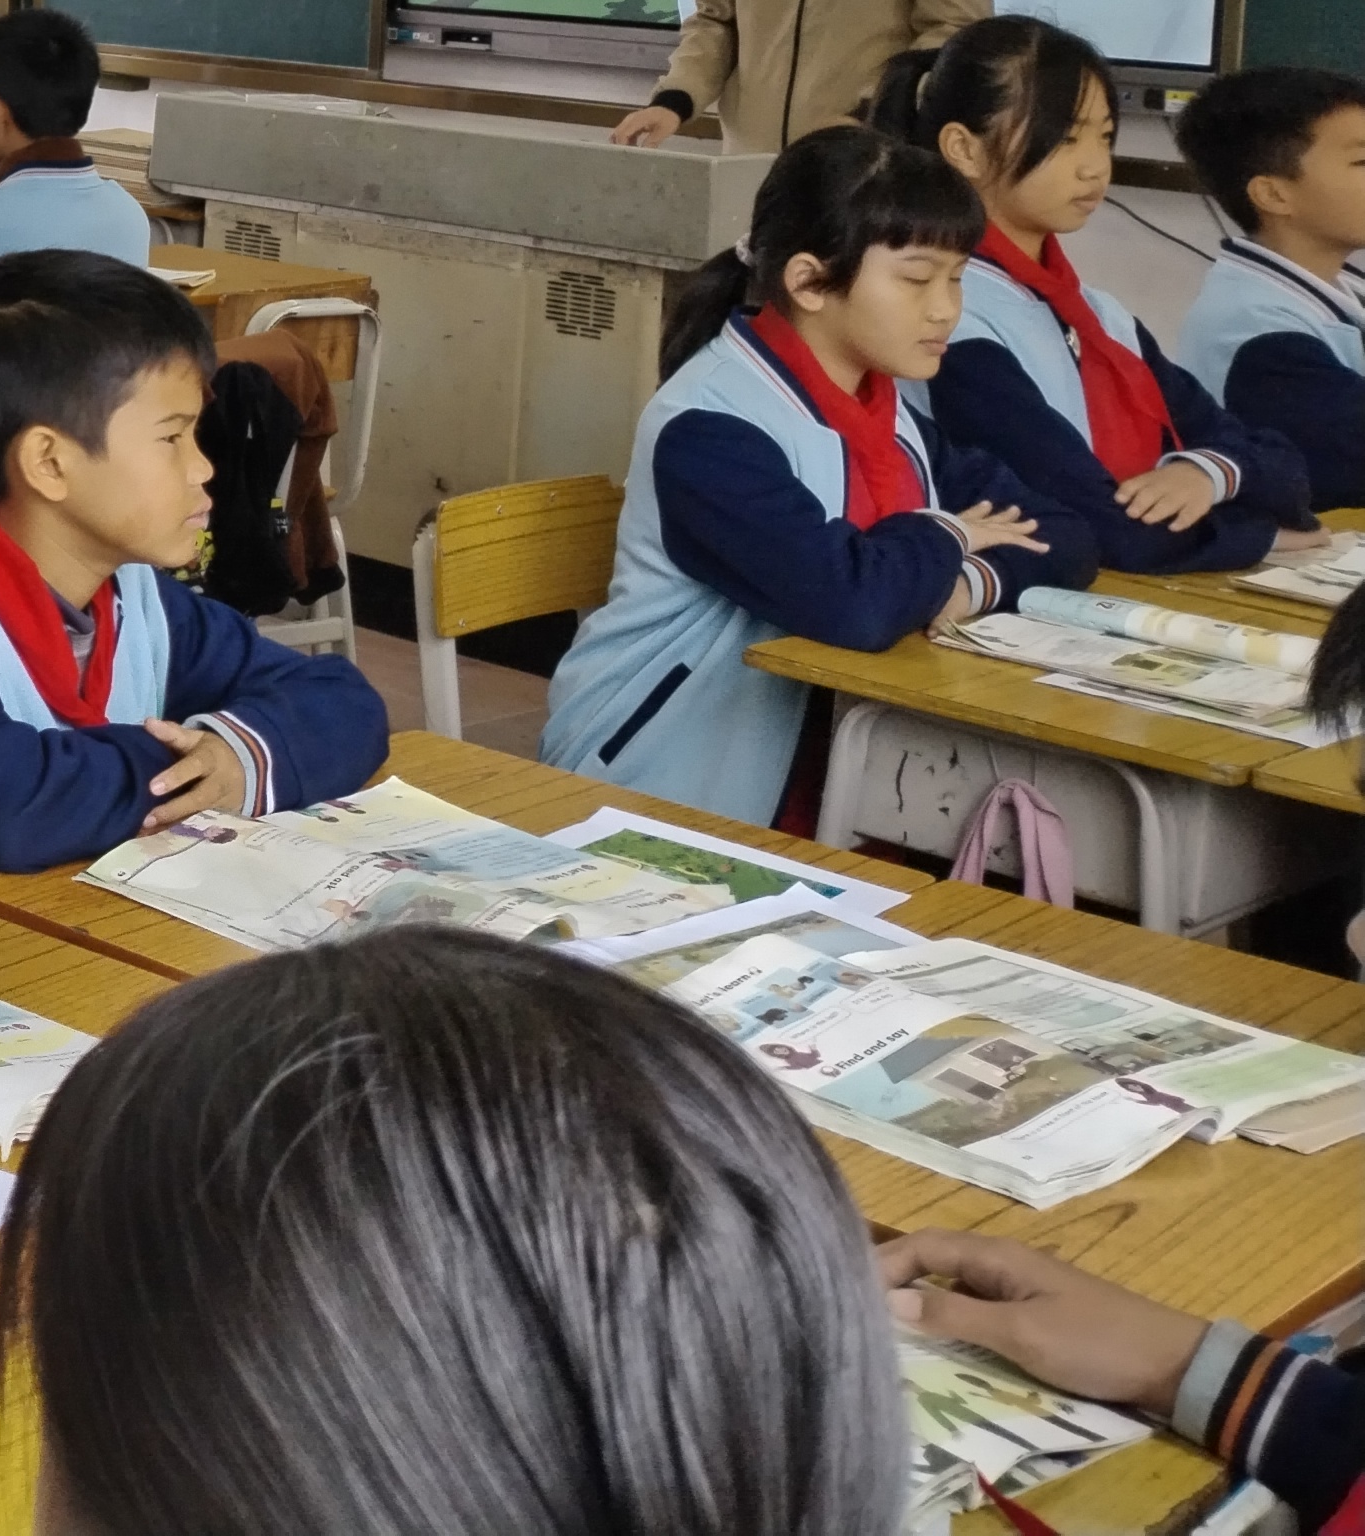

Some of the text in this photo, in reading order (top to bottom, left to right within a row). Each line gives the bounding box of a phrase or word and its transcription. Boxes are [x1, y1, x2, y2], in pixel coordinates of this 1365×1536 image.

[718, 974, 751, 992] learn
[836, 1027, 910, 1070] Find and say
